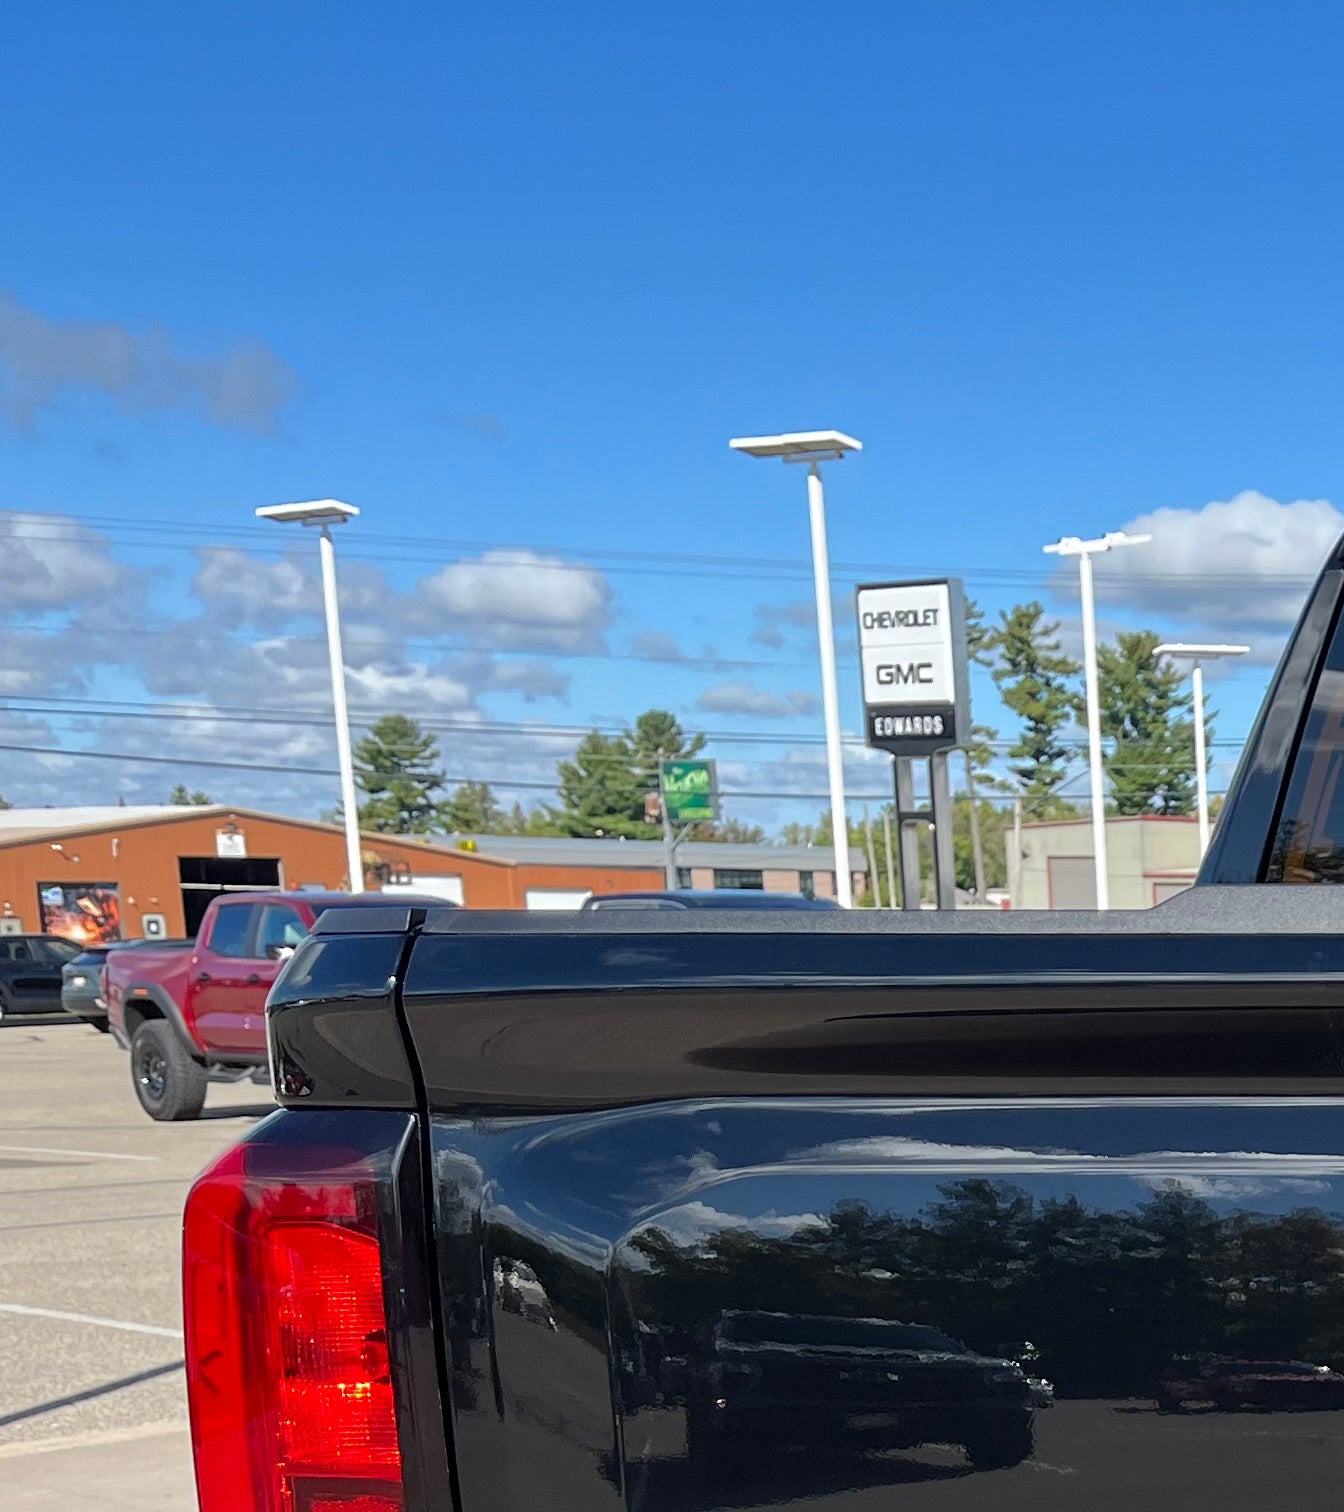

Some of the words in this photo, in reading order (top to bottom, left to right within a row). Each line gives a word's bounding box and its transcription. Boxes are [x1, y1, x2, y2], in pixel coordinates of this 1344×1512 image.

[862, 609, 938, 630] CHEVROLET
[876, 662, 934, 685] GMC
[874, 715, 944, 736] EDWARDS
